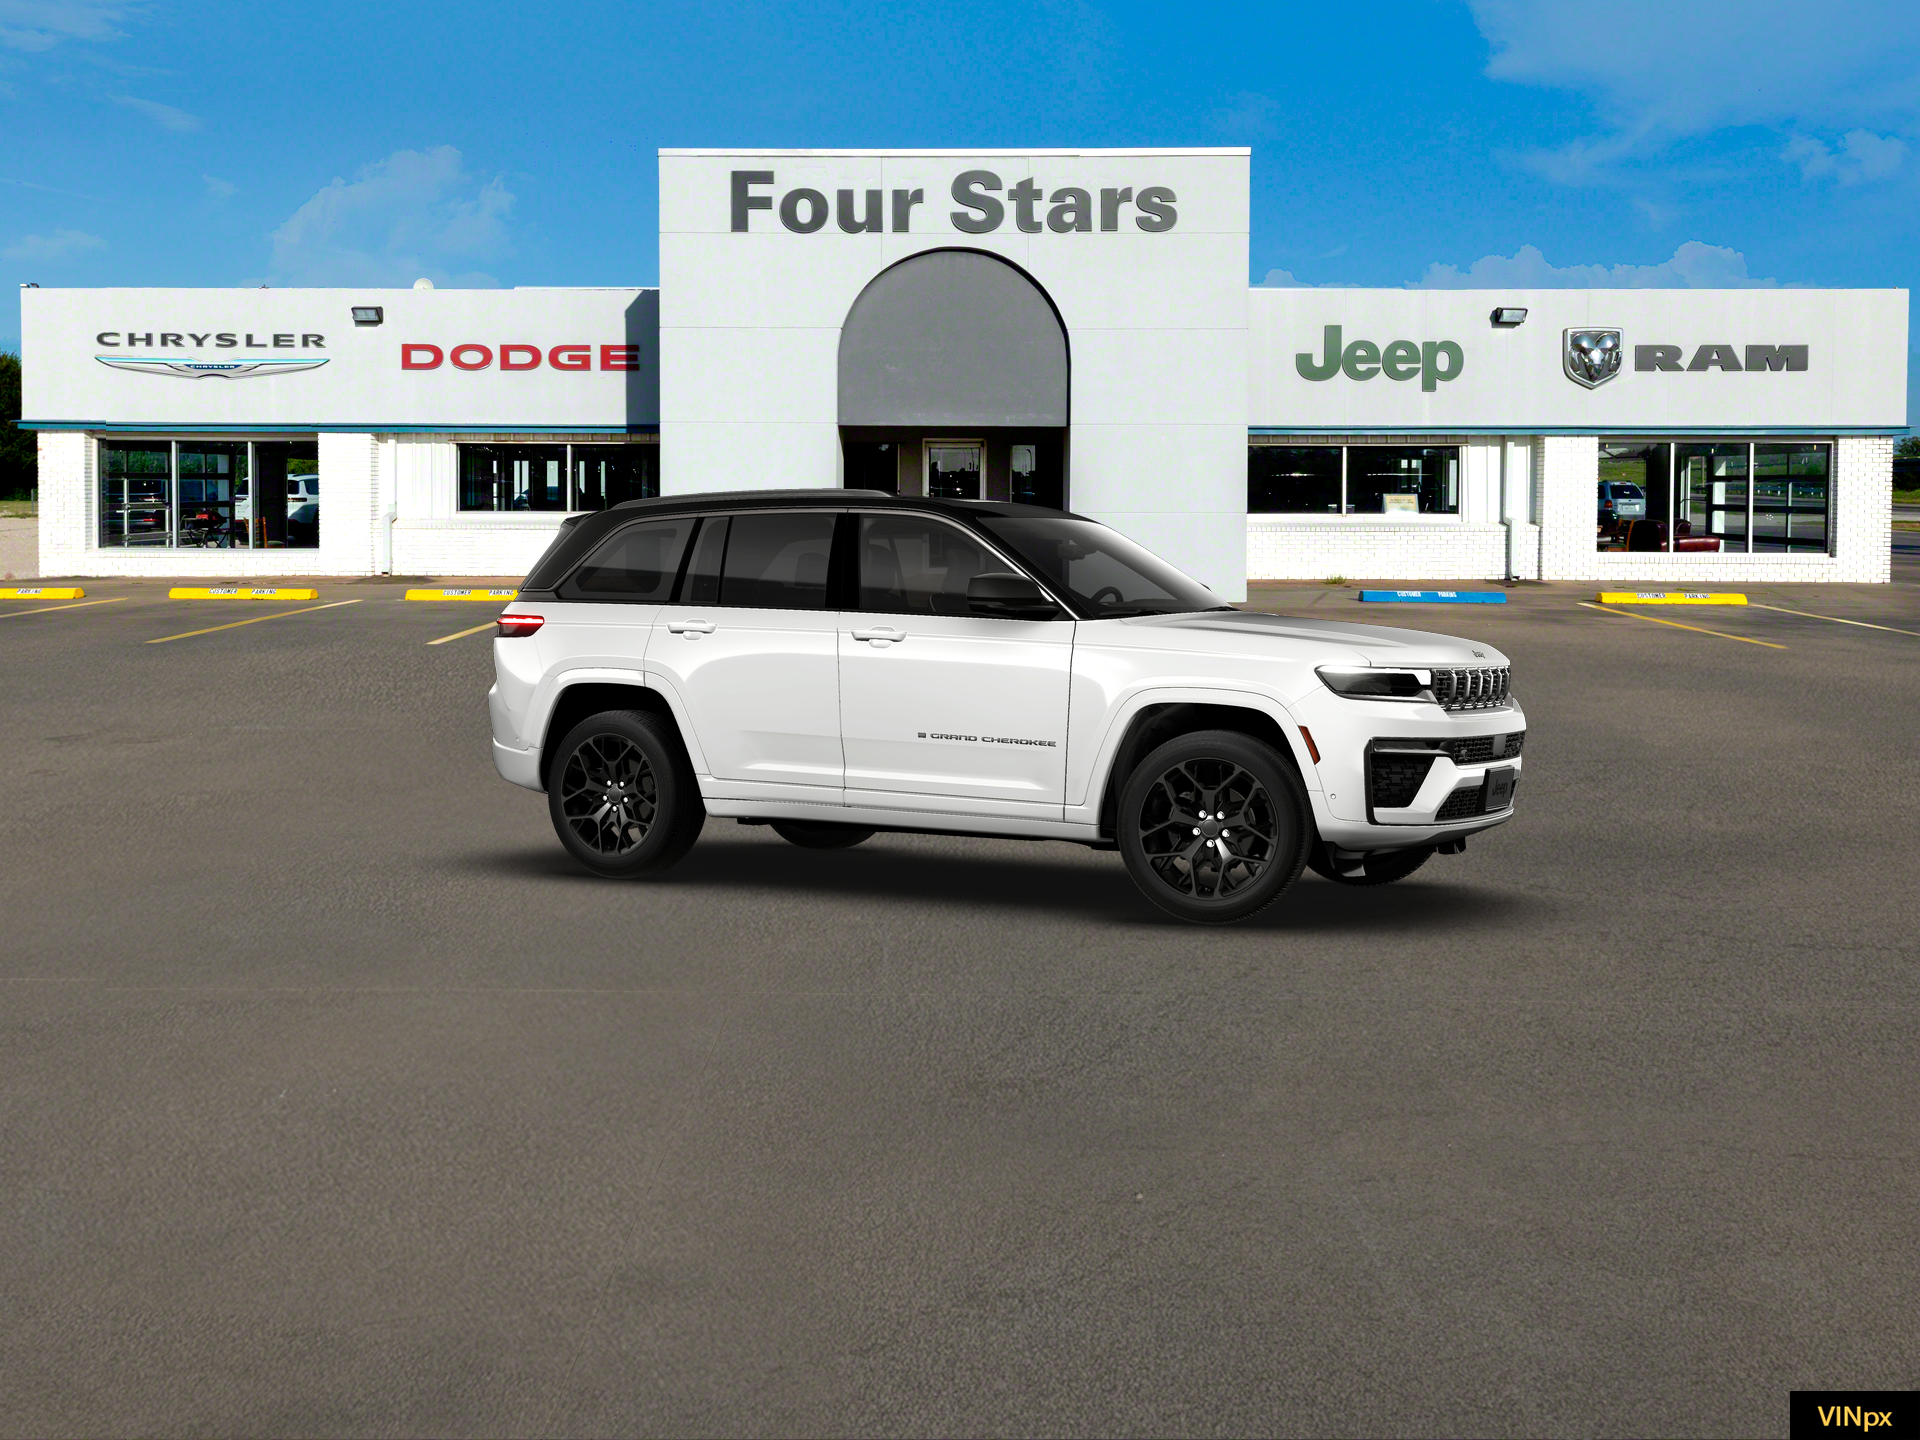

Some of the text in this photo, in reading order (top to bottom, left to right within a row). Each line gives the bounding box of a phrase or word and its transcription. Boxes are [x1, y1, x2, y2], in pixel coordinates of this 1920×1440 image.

[730, 169, 1178, 233] Four Stars
[96, 332, 326, 348] CHRYSLER
[401, 343, 640, 371] DODGE
[1295, 325, 1464, 392] Jeep
[1634, 344, 1808, 372] RAM
[930, 733, 1057, 747] GRAND CHEROKEE
[1492, 779, 1508, 798] Jeep
